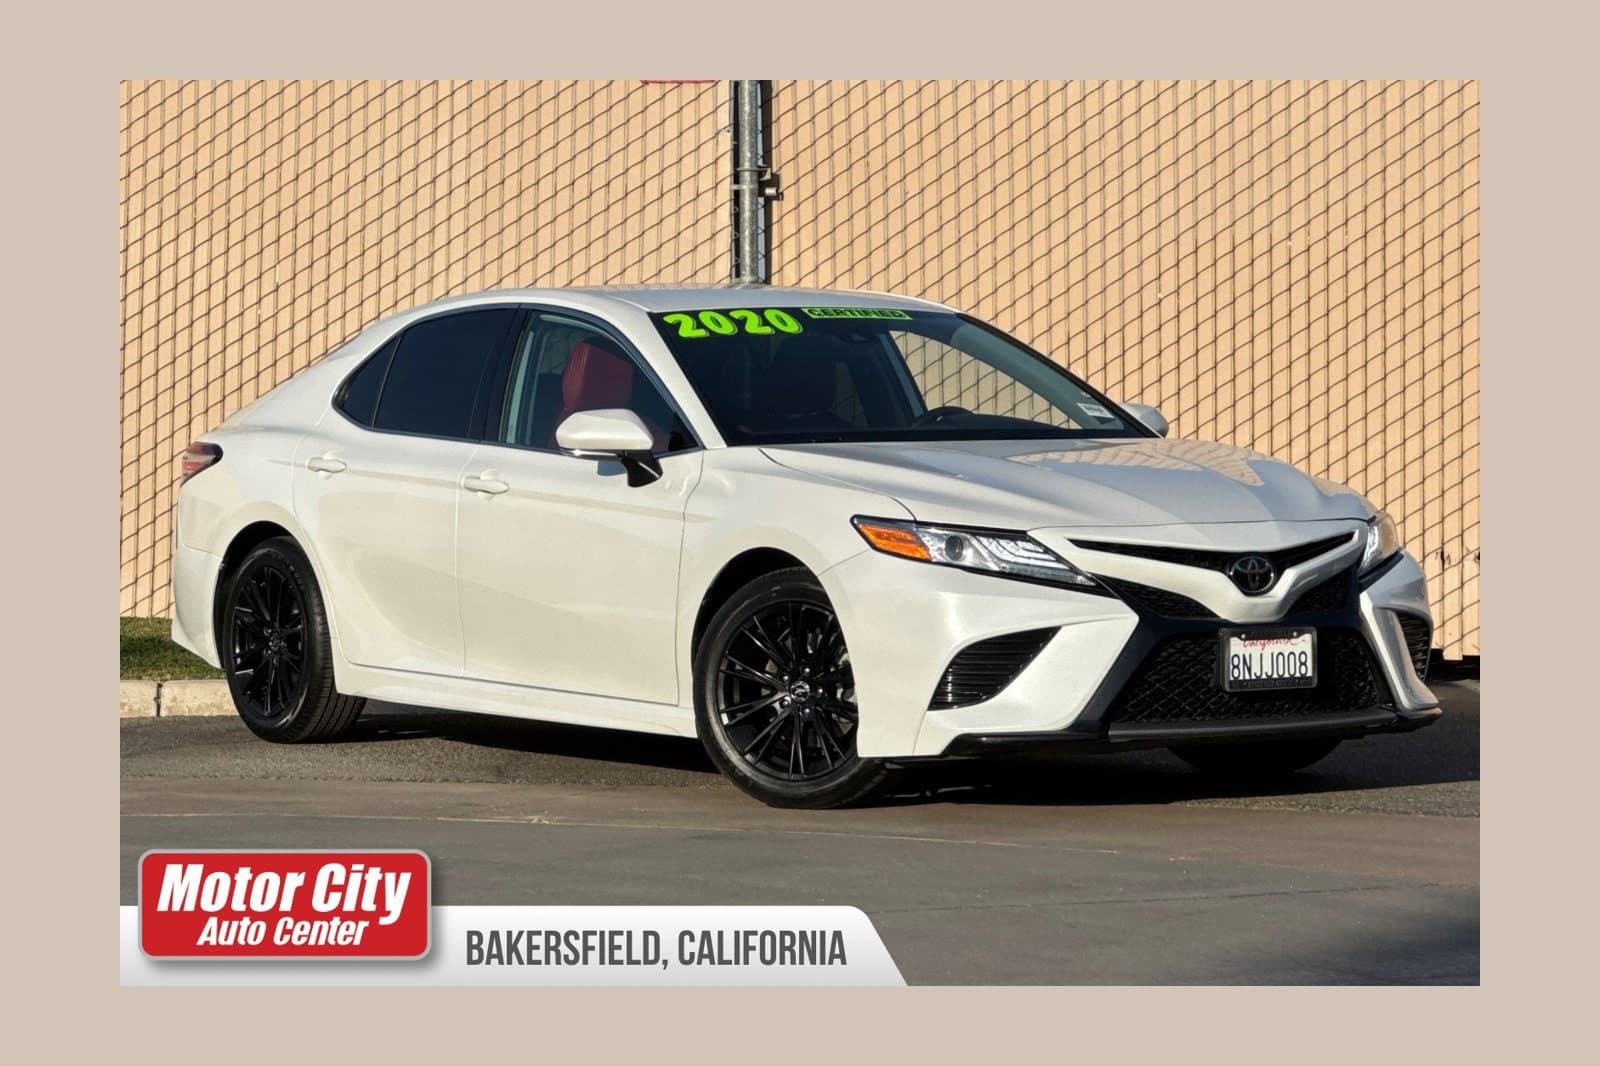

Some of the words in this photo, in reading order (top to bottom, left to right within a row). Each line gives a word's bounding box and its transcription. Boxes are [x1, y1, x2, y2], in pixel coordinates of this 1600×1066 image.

[663, 308, 803, 339] 2020
[807, 307, 907, 319] CERTIFIED
[1231, 651, 1308, 680] 8NJJ008
